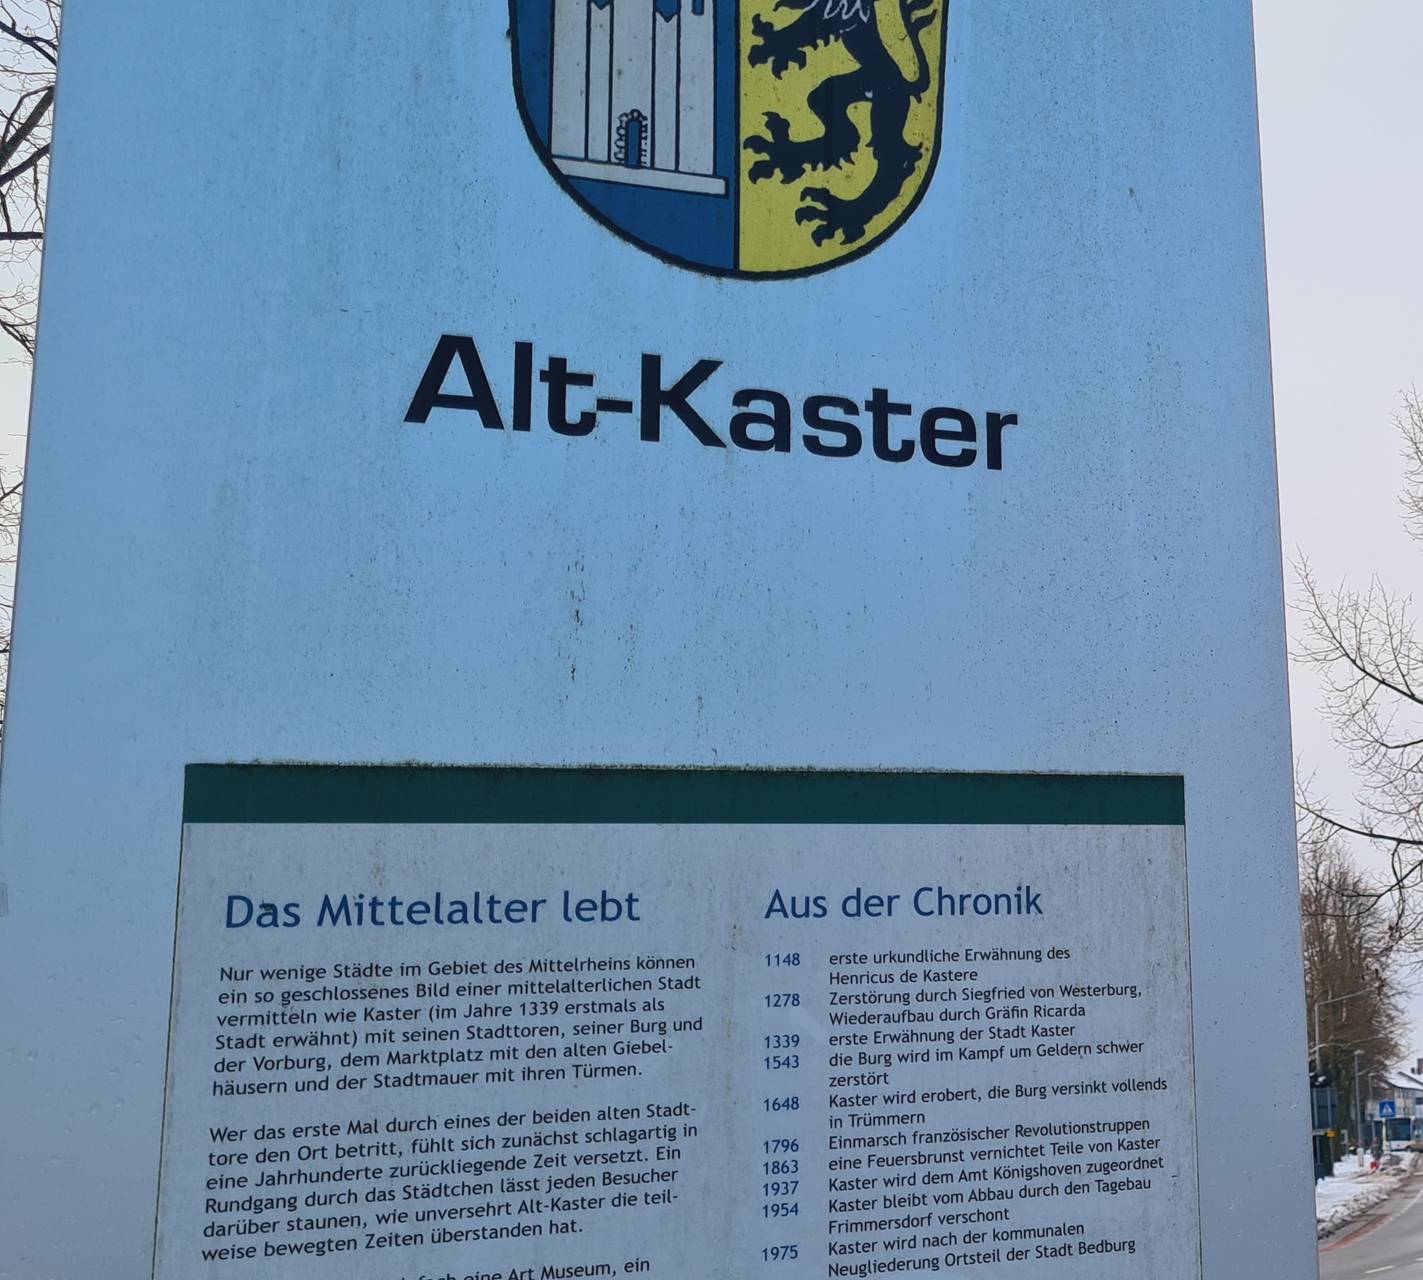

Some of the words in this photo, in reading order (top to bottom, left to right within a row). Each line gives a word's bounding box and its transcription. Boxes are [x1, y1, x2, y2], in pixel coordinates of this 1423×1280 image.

[404, 333, 1018, 471] Alt-Kaster
[225, 894, 301, 929] Das
[316, 891, 548, 927] Mittelalter
[562, 889, 641, 923] lebt
[763, 887, 828, 920] Aus
[841, 886, 901, 918] der
[913, 881, 1044, 917] Chronik
[219, 965, 255, 982] Nur
[259, 964, 327, 984] wenige
[333, 961, 394, 979] Städte
[399, 961, 422, 977] im
[427, 959, 489, 976] Gebiet
[493, 959, 523, 975] des
[528, 956, 631, 973] Mittelrheins
[636, 955, 695, 971] können
[764, 952, 801, 968] 1148
[829, 951, 869, 966] erste
[873, 948, 961, 965] urkundliche
[964, 947, 1043, 963] Erwähnung
[1046, 945, 1071, 961] des
[217, 988, 248, 1005] ein
[254, 991, 275, 1004] so
[280, 983, 410, 1007] geschlossenes
[415, 981, 450, 999] Bild
[455, 981, 503, 997] einer
[507, 976, 653, 996] mittelalterlichen
[657, 975, 702, 991] Stadt
[829, 970, 895, 986] Henricus
[899, 969, 919, 984] de
[923, 968, 979, 983] Kastere
[216, 1006, 317, 1027] vermitteln
[323, 1007, 357, 1024] wie
[363, 1006, 423, 1023] Kaster
[428, 1004, 457, 1024] (im
[463, 1002, 513, 1019] Jahre
[519, 1000, 559, 1017] 1339
[564, 997, 637, 1015] erstmals
[641, 996, 665, 1013] als
[764, 992, 801, 1009] 1278
[828, 989, 911, 1007] Zerstörung
[915, 987, 957, 1003] durch
[961, 985, 1026, 1004] Siegfried
[1029, 987, 1055, 999] von
[1058, 983, 1142, 999] Westerburg,
[828, 1008, 935, 1027] Wiederaufbau
[938, 1006, 981, 1022] durch
[985, 1005, 1029, 1021] Gräfin
[1033, 1002, 1086, 1019] Ricarda
[215, 1032, 267, 1051] Stadt
[272, 1029, 358, 1049] erwähnt)
[364, 1028, 396, 1045] mit
[401, 1026, 460, 1043] seinen
[465, 1023, 565, 1041] Stadttoren,
[572, 1020, 625, 1037] seiner
[630, 1019, 668, 1036] Burg
[672, 1015, 703, 1032] und
[763, 1033, 801, 1049] 1339
[828, 1032, 869, 1047] erste
[873, 1028, 955, 1045] Erwähnung
[959, 1026, 985, 1041] der
[988, 1024, 1027, 1040] Stadt
[1031, 1023, 1077, 1038] Kaster
[213, 1057, 247, 1074] der
[252, 1054, 332, 1073] Vorburg,
[339, 1051, 380, 1068] dem
[385, 1047, 484, 1068] Marktplatz
[489, 1045, 520, 1062] mit
[525, 1043, 557, 1060] den
[562, 1041, 607, 1058] alten
[612, 1038, 673, 1056] Giebel-
[763, 1054, 800, 1071] 1543
[828, 1052, 853, 1067] die
[858, 1051, 893, 1068] Burg
[896, 1047, 931, 1065] wird
[935, 1047, 954, 1063] im
[958, 1045, 1006, 1063] Kampf
[1009, 1047, 1032, 1059] um
[1035, 1042, 1092, 1060] Geldern
[1095, 1039, 1145, 1055] schwer
[212, 1079, 288, 1097] häusern
[294, 1075, 330, 1093] und
[335, 1074, 368, 1091] der
[373, 1071, 480, 1089] Stadtmauer
[485, 1067, 516, 1084] mit
[521, 1065, 566, 1082] ihren
[571, 1062, 643, 1081] Türmen.
[763, 1095, 800, 1113] 1648
[829, 1093, 879, 1109] Kaster
[882, 1089, 917, 1105] wird
[920, 1087, 982, 1103] erobert,
[987, 1085, 1011, 1100] die
[1015, 1083, 1048, 1101] Burg
[1050, 1079, 1108, 1097] versinkt
[1111, 1076, 1168, 1093] vollends
[828, 1071, 891, 1088] zerstört
[763, 1137, 800, 1155] 1796
[828, 1131, 907, 1151] Einmarsch
[911, 1125, 1011, 1145] französischer
[1014, 1119, 1151, 1139] Revolutionstruppen
[828, 1115, 843, 1129] in
[847, 1112, 926, 1129] Trümmern
[762, 1159, 799, 1176] 1863
[828, 1155, 863, 1171] eine
[867, 1149, 966, 1169] Feuersbrunst
[969, 1143, 1046, 1161] vernichtet
[1049, 1140, 1085, 1157] Teile
[1087, 1141, 1113, 1153] von
[1117, 1137, 1161, 1152] Kaster
[205, 1194, 298, 1215] Rundgang
[304, 1188, 359, 1208] durch
[364, 1186, 397, 1203] das
[401, 1180, 494, 1201] Städtchen
[500, 1177, 541, 1194] lässt
[545, 1173, 596, 1195] jeden
[601, 1167, 679, 1187] Besucher
[203, 1218, 281, 1238] darüber
[286, 1215, 368, 1232] staunen,
[375, 1208, 409, 1225] wie
[415, 1201, 513, 1223] unversehrt
[517, 1196, 607, 1215] Alt-Kaster
[610, 1191, 639, 1208] die
[643, 1188, 679, 1206] teil-
[201, 1243, 257, 1262] weise
[263, 1237, 358, 1257] bewegten
[364, 1231, 424, 1250] Zeiten
[430, 1221, 543, 1245] überstanden
[549, 1218, 583, 1235] hat.
[761, 1244, 799, 1262] 1975
[828, 1240, 879, 1257] Kaster
[882, 1233, 917, 1252] wird
[921, 1231, 958, 1249] nach
[962, 1229, 989, 1245] der
[992, 1221, 1085, 1243] kommunalen
[507, 1267, 536, 1280] Art
[540, 1262, 617, 1280] Museum,
[623, 1257, 651, 1274] ein
[828, 1256, 941, 1279] Neugliederung
[944, 1247, 1002, 1267] Ortsteil
[1005, 1246, 1031, 1262] der
[1035, 1242, 1074, 1259] Stadt
[1077, 1239, 1137, 1256] Bedburg
